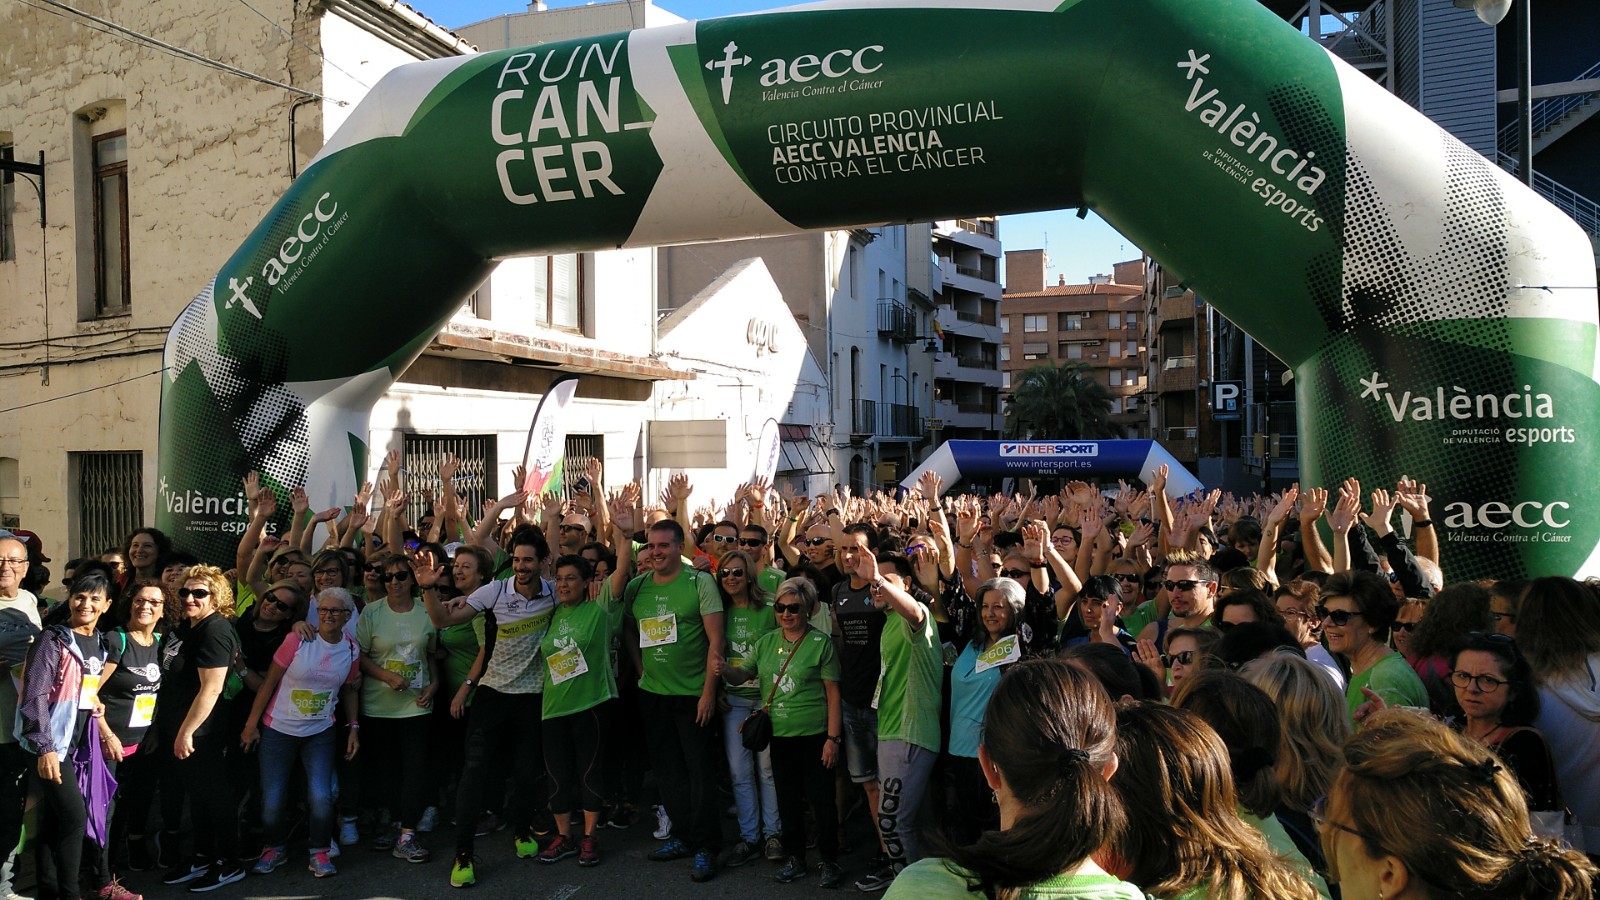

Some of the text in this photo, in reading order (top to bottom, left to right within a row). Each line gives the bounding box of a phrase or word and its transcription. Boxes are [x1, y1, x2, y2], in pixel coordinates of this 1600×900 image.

[497, 39, 625, 90] RUN
[760, 45, 884, 87] aecc
[762, 78, 884, 102] Valencia Contra el Cáncer
[767, 99, 1004, 145] CIRCUITO PROVINCIAL
[1184, 77, 1326, 196] València
[772, 129, 943, 165] AECC VALENCIA
[1202, 150, 1214, 160] DE
[1215, 147, 1254, 177] DIPUTACIÓ
[495, 140, 626, 206] CER
[775, 147, 987, 185] CONTRA EL CÁNCER
[1251, 177, 1325, 233] esports
[262, 191, 338, 286] aecc
[277, 210, 350, 295] Valencia Contra el Cáncer
[1215, 383, 1239, 410] P
[1384, 384, 1554, 422] València
[1017, 445, 1095, 454] INTERSPORT
[1452, 427, 1500, 436] DIPUTACIÓ
[1505, 425, 1575, 447] esports
[1444, 501, 1570, 528] aecc
[1447, 531, 1572, 543] Valencia Contra el Cáncer
[646, 626, 673, 637] 40494
[295, 698, 327, 709] 30539
[877, 777, 908, 879] adidas
